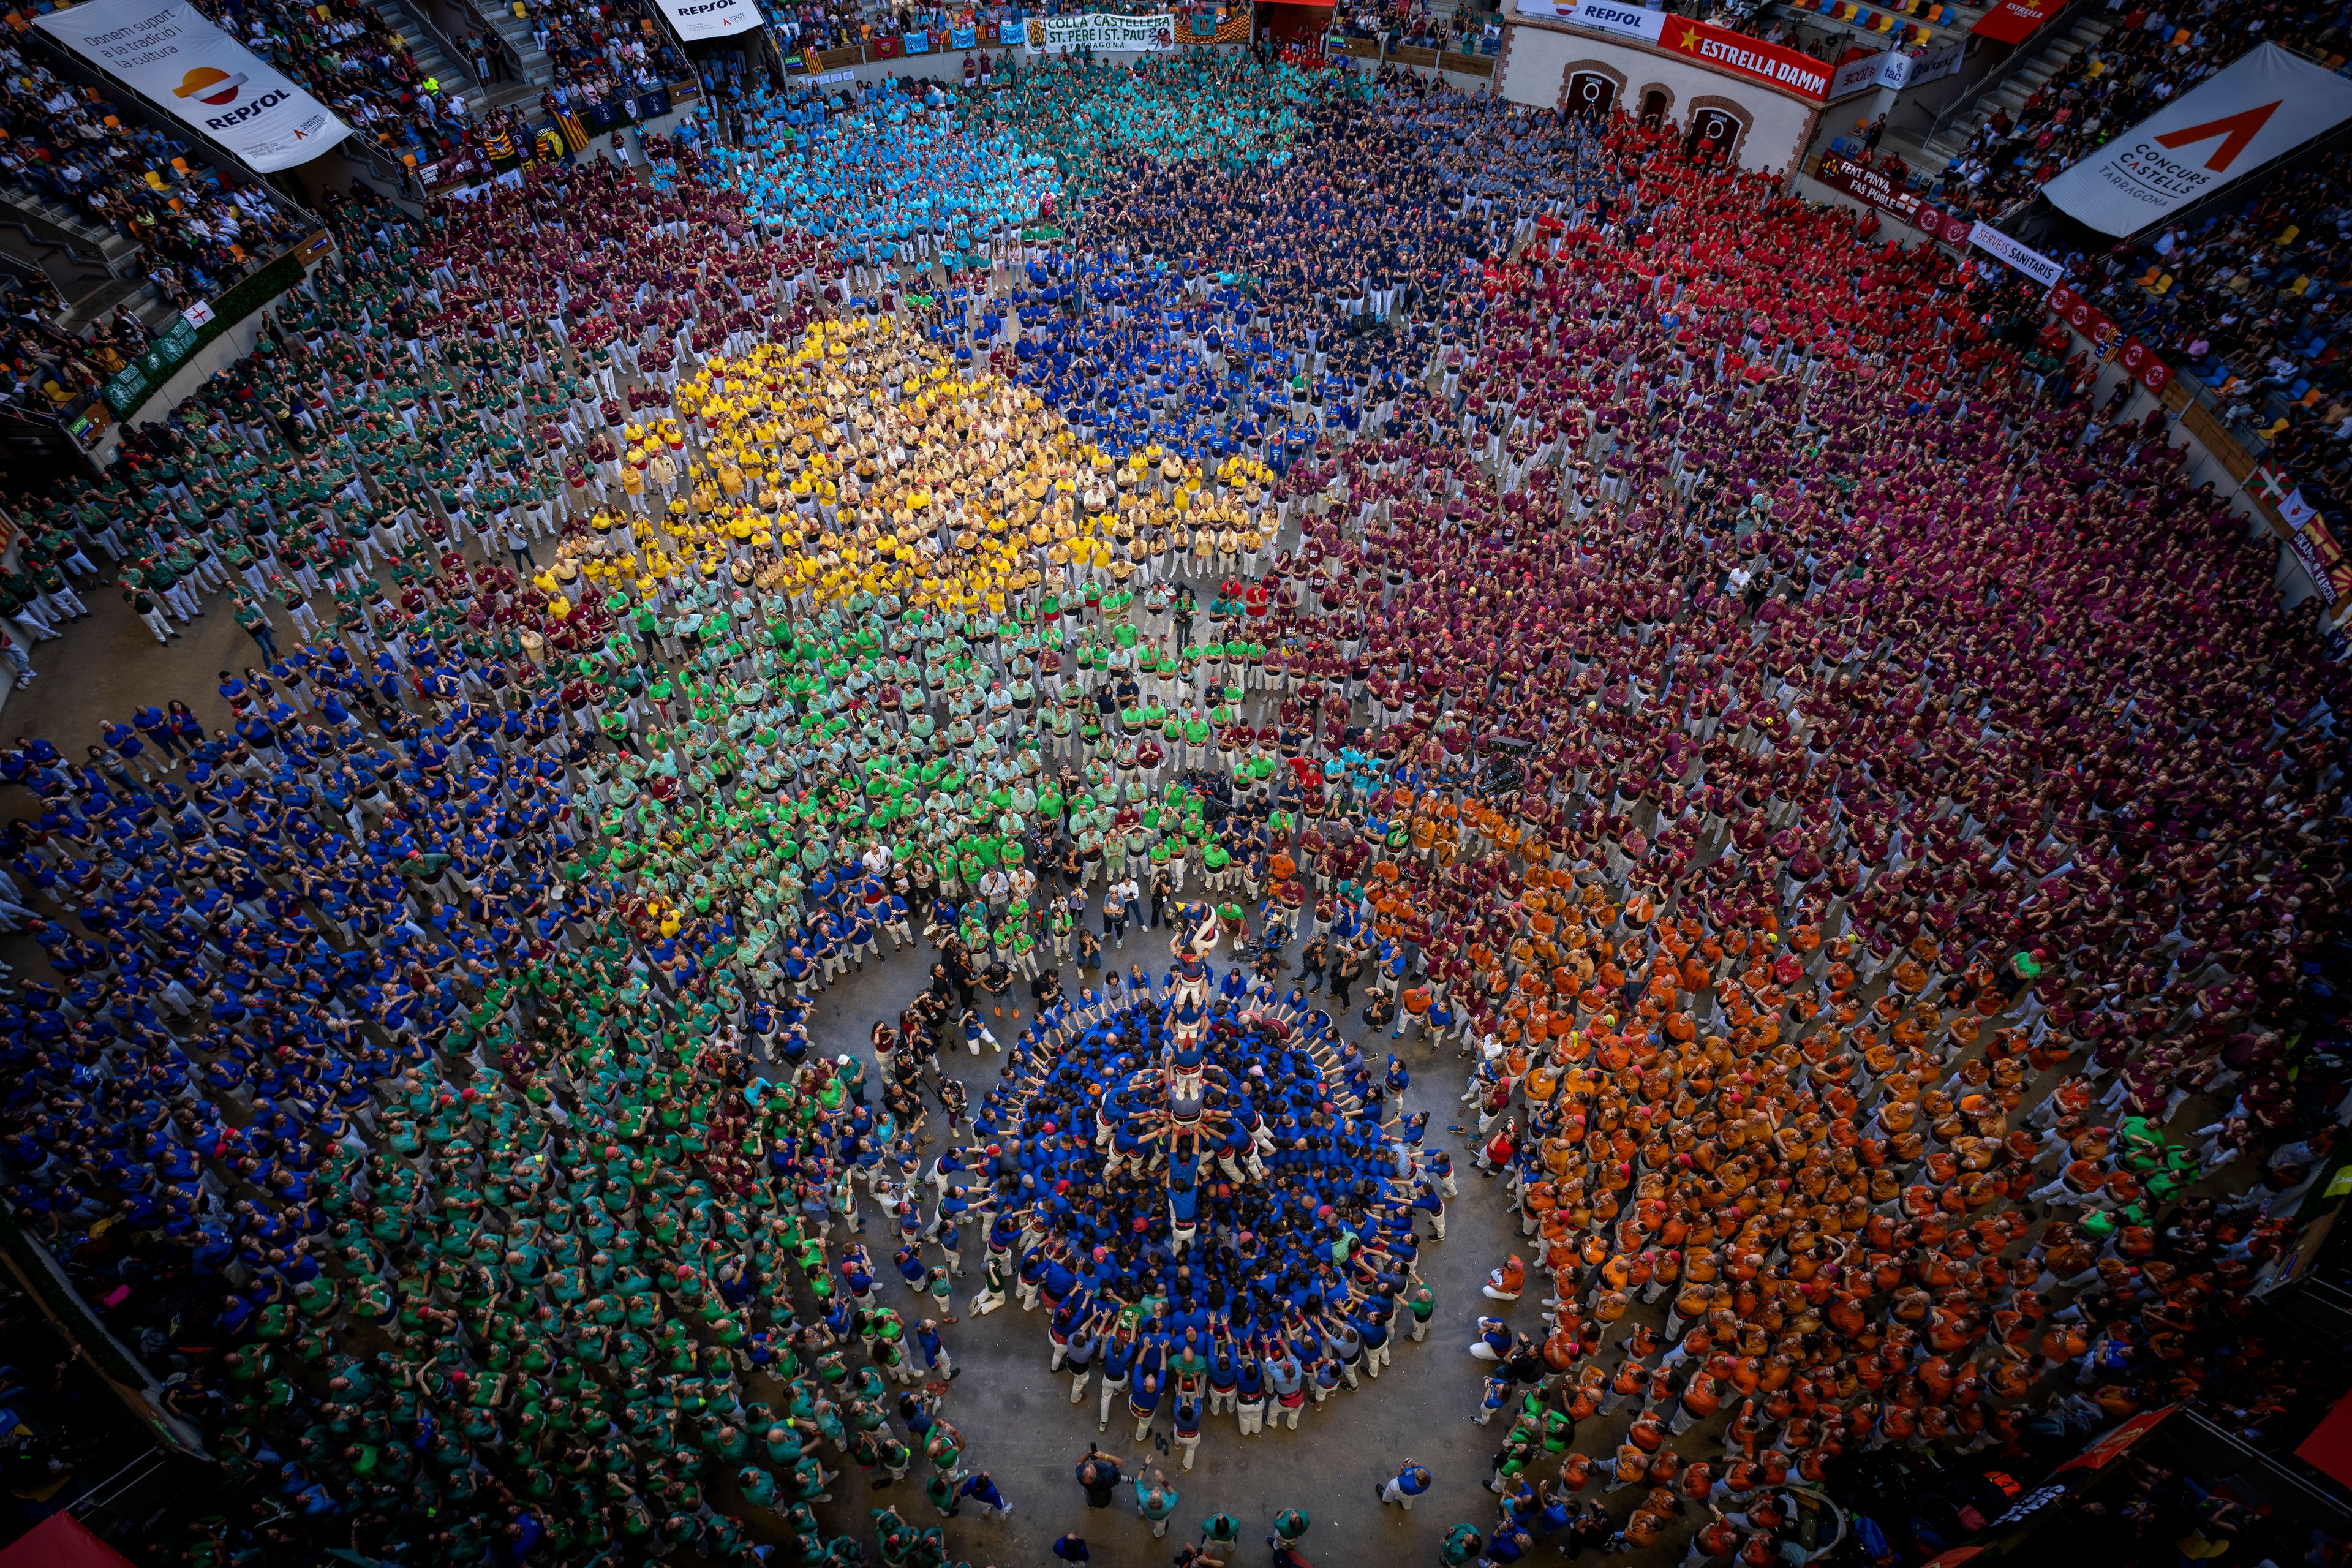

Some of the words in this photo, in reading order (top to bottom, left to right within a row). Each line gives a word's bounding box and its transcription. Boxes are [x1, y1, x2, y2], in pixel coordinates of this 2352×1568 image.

[677, 0, 736, 16] REPSOL
[1048, 17, 1088, 29] COLLA
[1094, 15, 1170, 28] CASTELLERA
[1585, 5, 1642, 28] REPSOL
[2005, 2, 2044, 19] ESTRELLA
[83, 27, 135, 47] Donem
[133, 9, 176, 32] suport
[109, 47, 129, 55] la
[125, 27, 176, 51] tradició
[172, 24, 183, 32] i
[1049, 31, 1065, 43] ST.
[1068, 29, 1096, 42] PERE
[1104, 28, 1120, 40] ST.
[1123, 29, 1145, 41] PAU
[113, 60, 133, 69] la
[132, 45, 178, 65] cultura
[1700, 38, 1776, 77] ESTRELLA
[1775, 62, 1827, 95] DAMM
[1921, 63, 1929, 74] la
[1885, 66, 1901, 81] tac
[205, 89, 291, 130] REPSOL
[1840, 161, 1864, 179] FENT
[1863, 171, 1891, 194] PINYA,
[2120, 153, 2195, 194] CASTELLS
[2135, 144, 2211, 184] CONCURS
[1850, 179, 1867, 195] FAS
[1866, 187, 1896, 209] POBLE
[2098, 165, 2169, 208] TARRAGONA
[1977, 230, 2011, 254] SERVEIS
[2008, 247, 2054, 279] SANITARIS
[73, 418, 88, 434] SORTIDA
[2315, 571, 2337, 605] KARCOL
